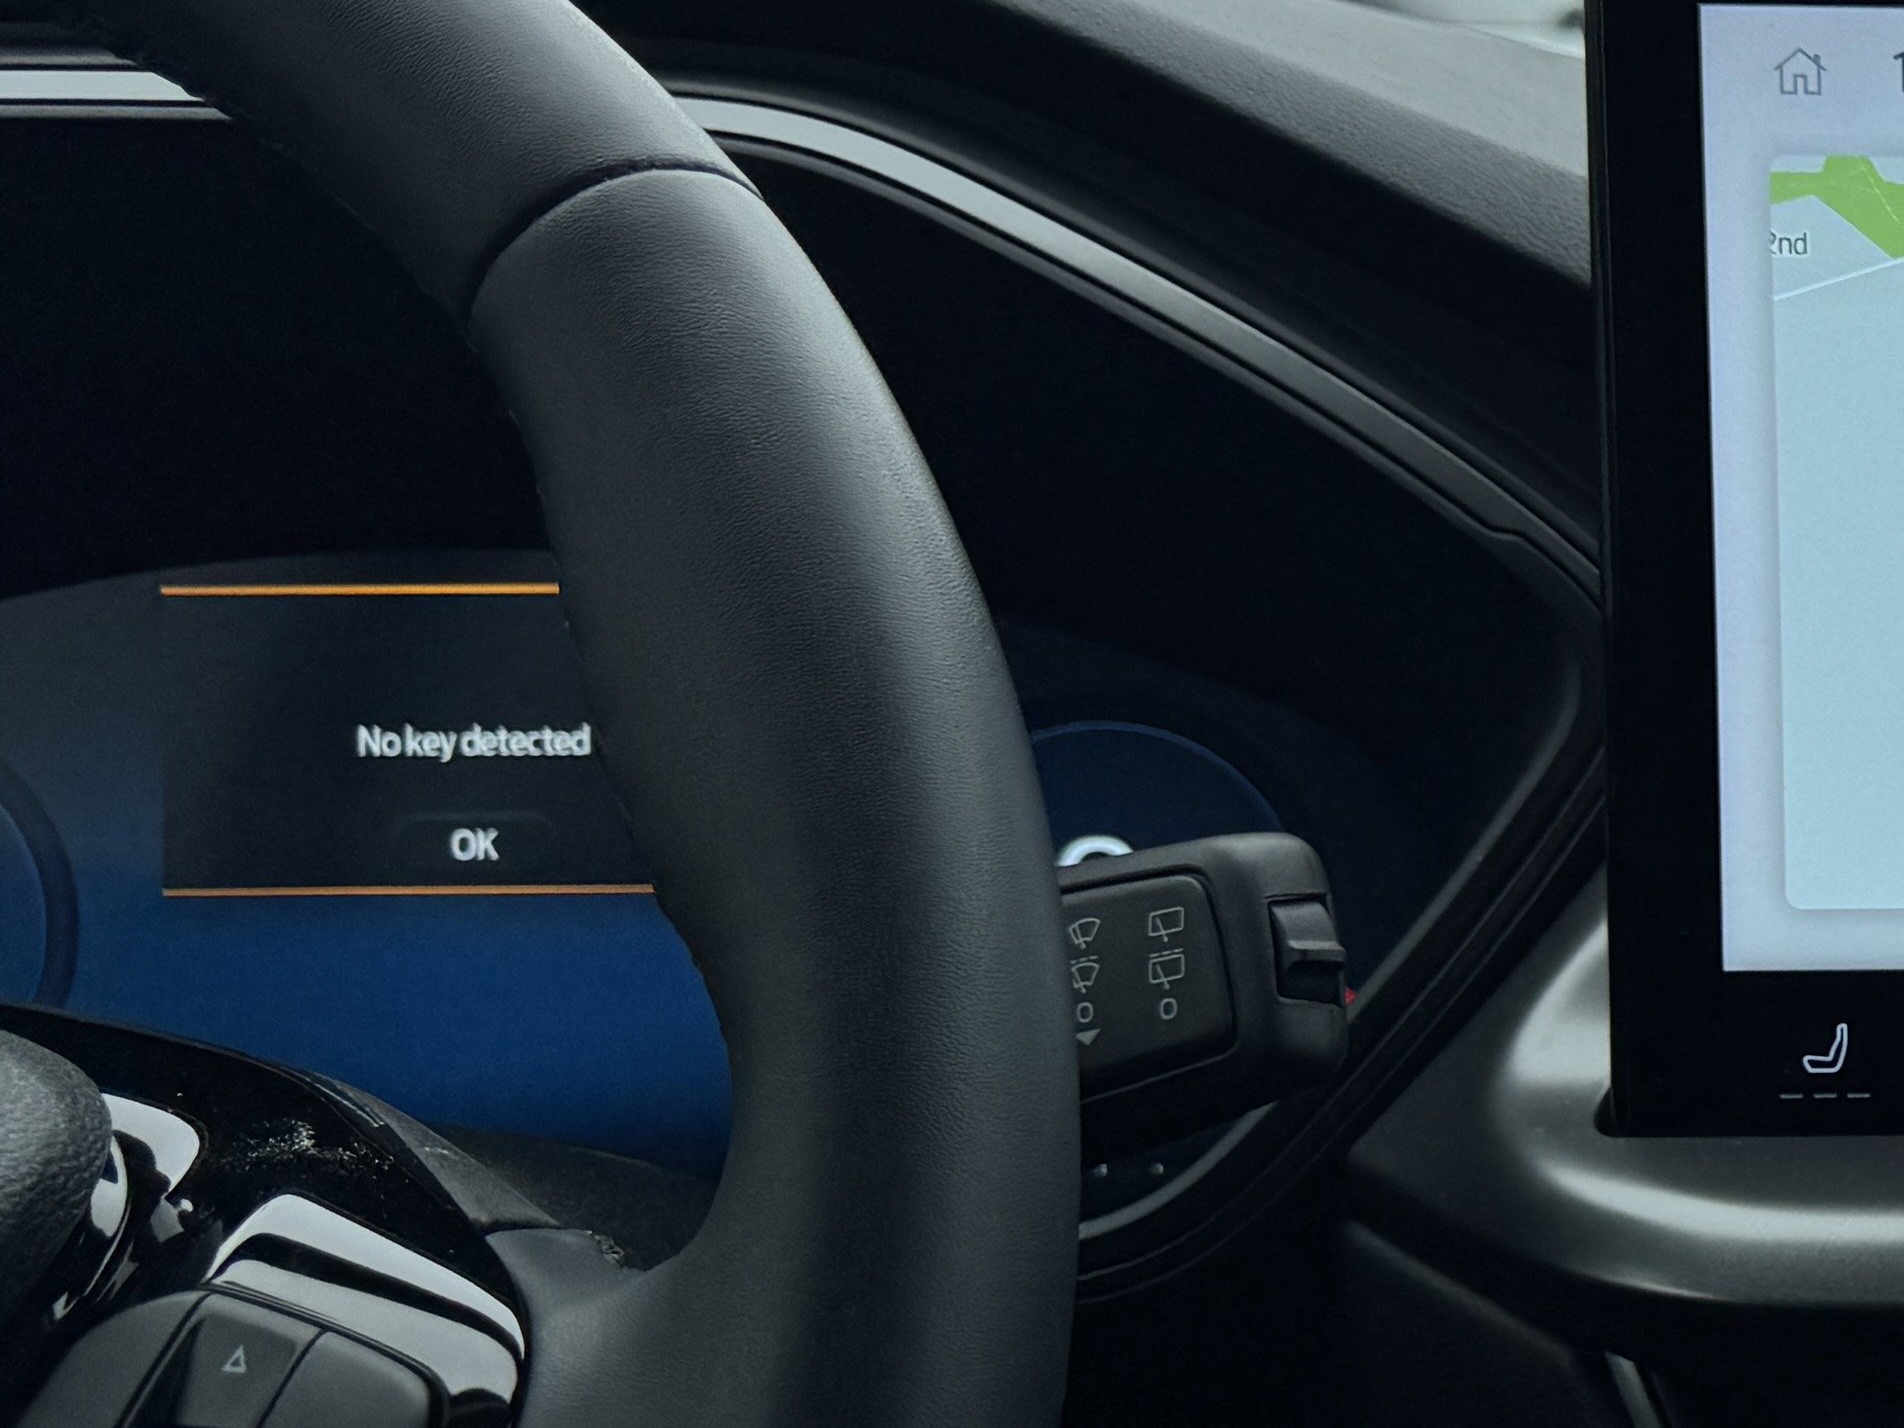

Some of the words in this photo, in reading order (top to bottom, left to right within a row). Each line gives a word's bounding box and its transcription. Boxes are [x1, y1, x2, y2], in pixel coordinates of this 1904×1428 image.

[356, 724, 401, 758] No
[404, 722, 458, 763] key
[460, 721, 592, 757] detected
[451, 827, 500, 862] OK
